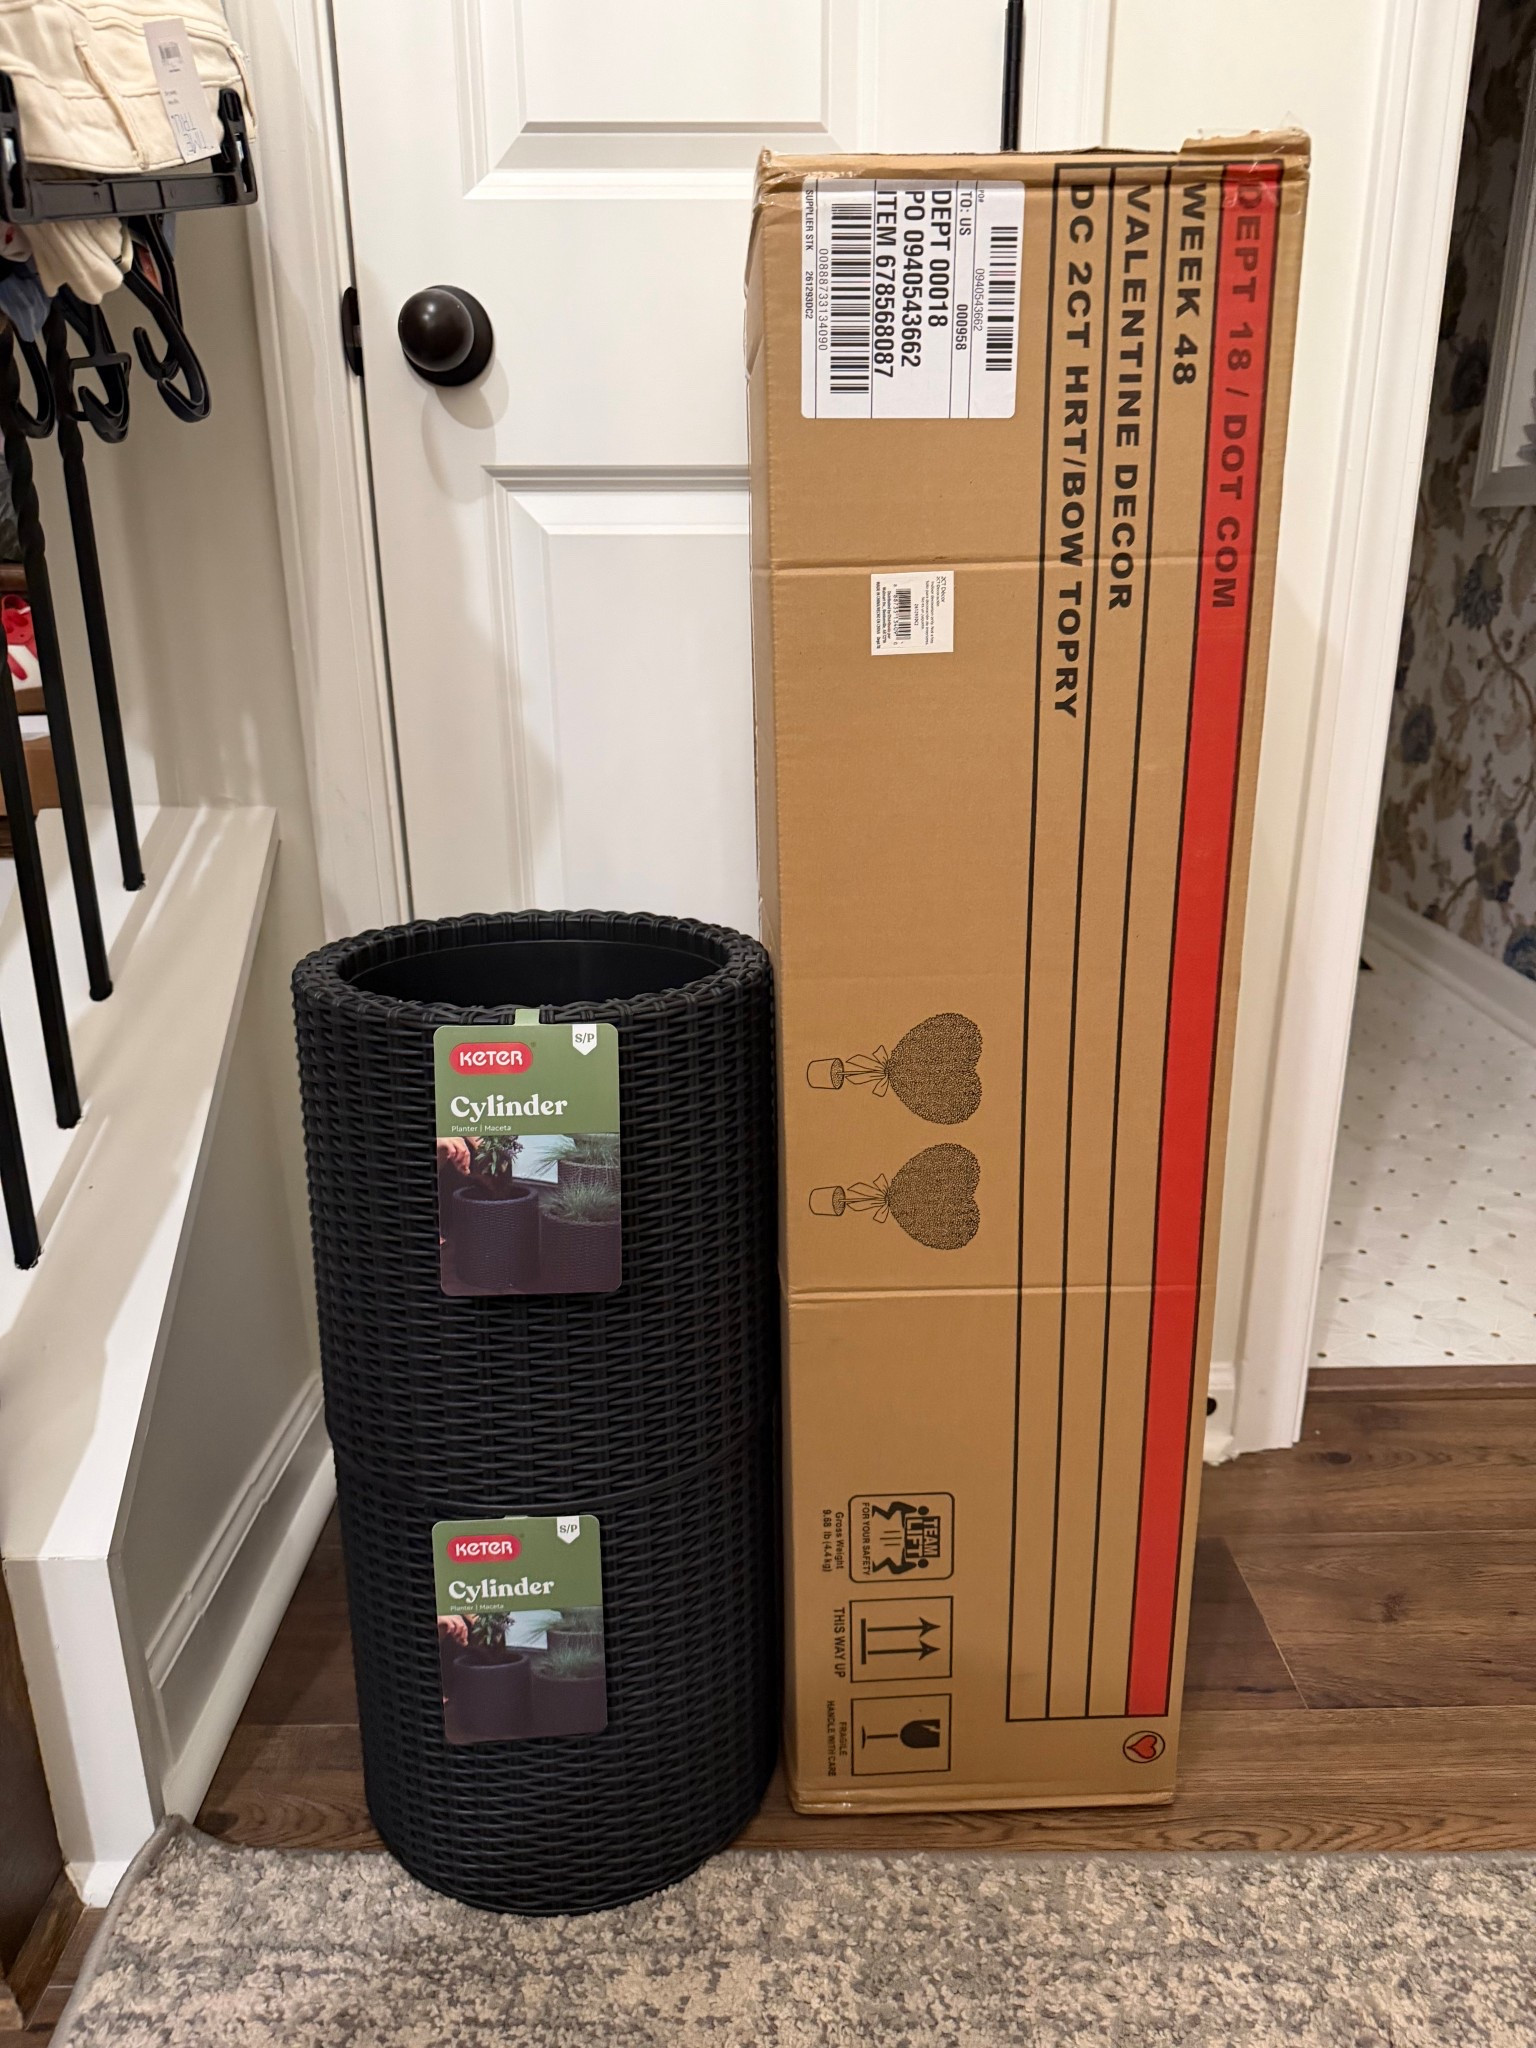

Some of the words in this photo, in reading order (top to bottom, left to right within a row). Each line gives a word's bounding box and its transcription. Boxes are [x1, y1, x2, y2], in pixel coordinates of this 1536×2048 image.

[805, 190, 814, 232] SUPPLIER
[876, 191, 897, 246] ITEM
[904, 191, 925, 221] PO
[930, 190, 952, 251] DEPT
[960, 191, 972, 213] TO:
[1068, 185, 1094, 244] DC
[805, 234, 814, 251] STK
[959, 218, 971, 236] US
[1234, 185, 1262, 302] DEPT
[1176, 184, 1206, 318] WEEK
[805, 271, 814, 320] 261293DC2
[818, 248, 829, 351] 00888733134090
[901, 230, 924, 368] 0940543662
[928, 259, 949, 327] 00018
[973, 268, 984, 331] 0940543662
[1065, 266, 1093, 349] 2CT
[874, 255, 895, 378] 678568087
[955, 304, 968, 351] 000958
[1116, 185, 1150, 448] VALENTINE
[1172, 335, 1198, 385] 48
[1227, 321, 1253, 370] 18
[1059, 367, 1090, 568] HRT/BOW
[1218, 414, 1246, 500] DOT
[1109, 464, 1138, 612] DECOR
[1212, 517, 1240, 608] COM
[1054, 582, 1082, 718] TOPRY
[575, 1033, 594, 1044] S/P
[459, 1050, 523, 1066] KETER
[450, 1094, 568, 1123] Cylinder
[451, 1124, 478, 1133] Planter
[485, 1124, 512, 1132] Maceta
[560, 1525, 578, 1533] S/P
[824, 1531, 832, 1539] lb
[836, 1512, 844, 1537] Gross
[862, 1521, 870, 1543] YOUR
[907, 1519, 922, 1557] LIFT
[924, 1519, 938, 1555] TEAM
[455, 1541, 513, 1556] KETER
[835, 1540, 844, 1569] Weight
[449, 1577, 555, 1603] Cylinder
[834, 1607, 845, 1634] THIS
[834, 1636, 846, 1661] WAY
[834, 1663, 846, 1678] UP
[827, 1701, 836, 1733] HANDLE
[828, 1734, 836, 1754] WITH
[839, 1722, 847, 1756] FRAGILE
[828, 1756, 836, 1776] CARE
